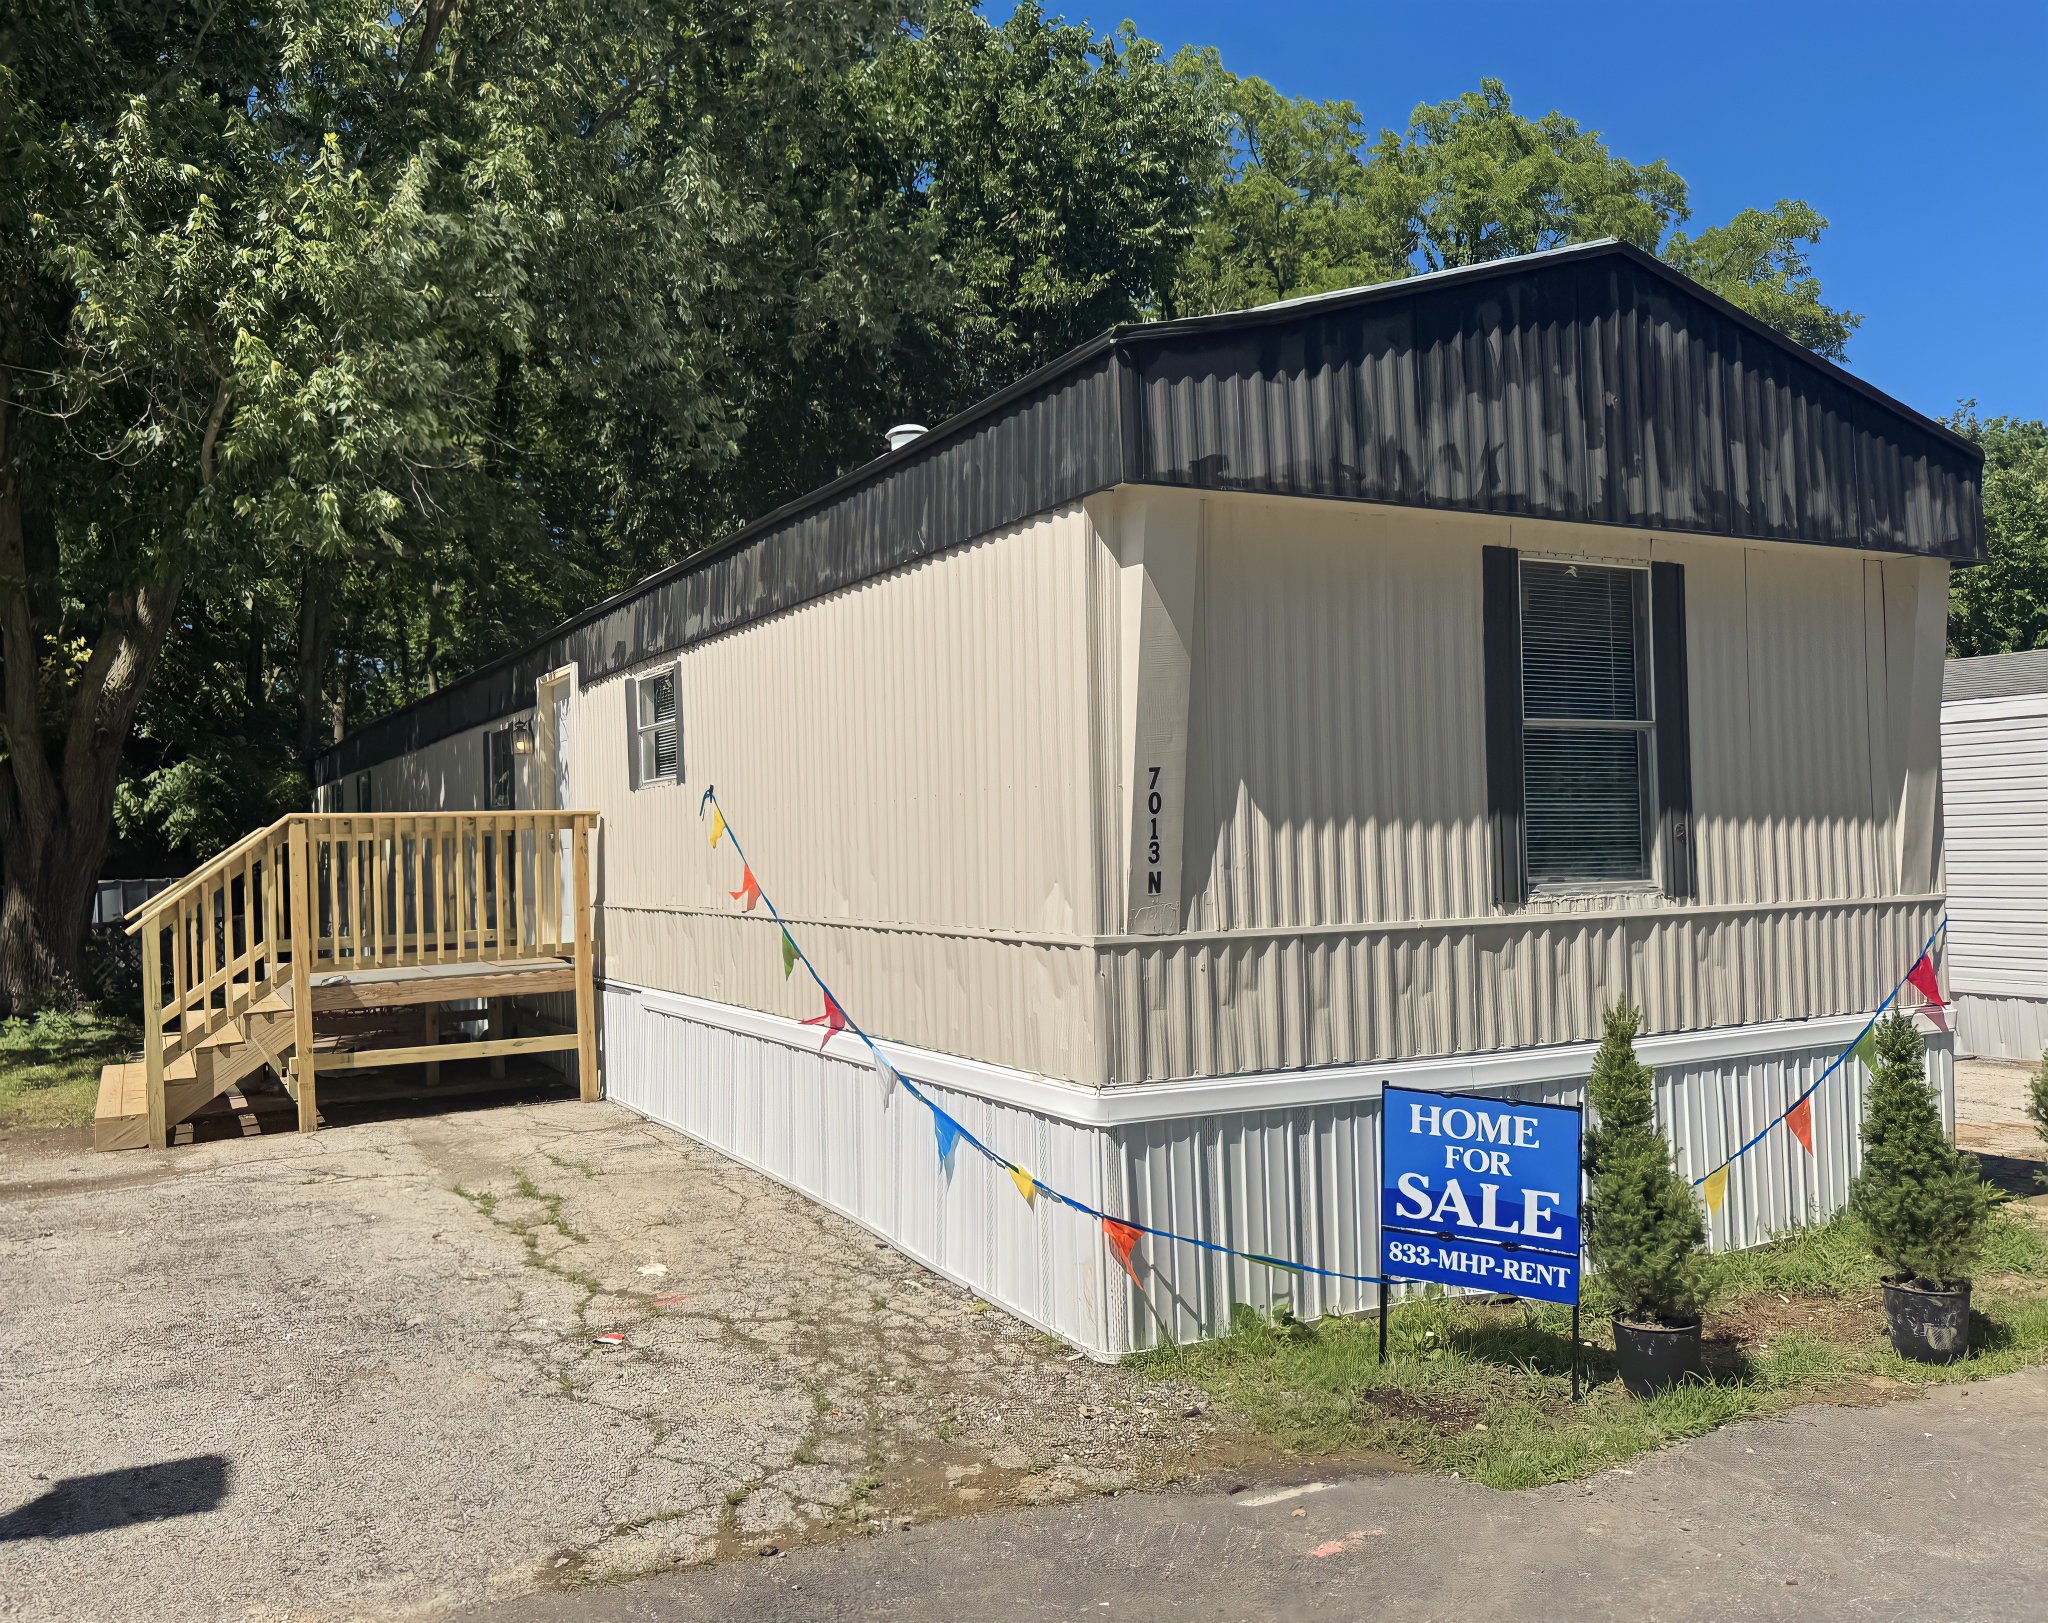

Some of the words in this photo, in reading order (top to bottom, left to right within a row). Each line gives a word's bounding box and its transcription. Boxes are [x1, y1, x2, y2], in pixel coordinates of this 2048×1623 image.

[1409, 1103, 1540, 1149] HOME
[1444, 1145, 1512, 1177] FOR
[1396, 1172, 1562, 1240] SALE
[1389, 1241, 1571, 1288] 833-MHP-RENT
